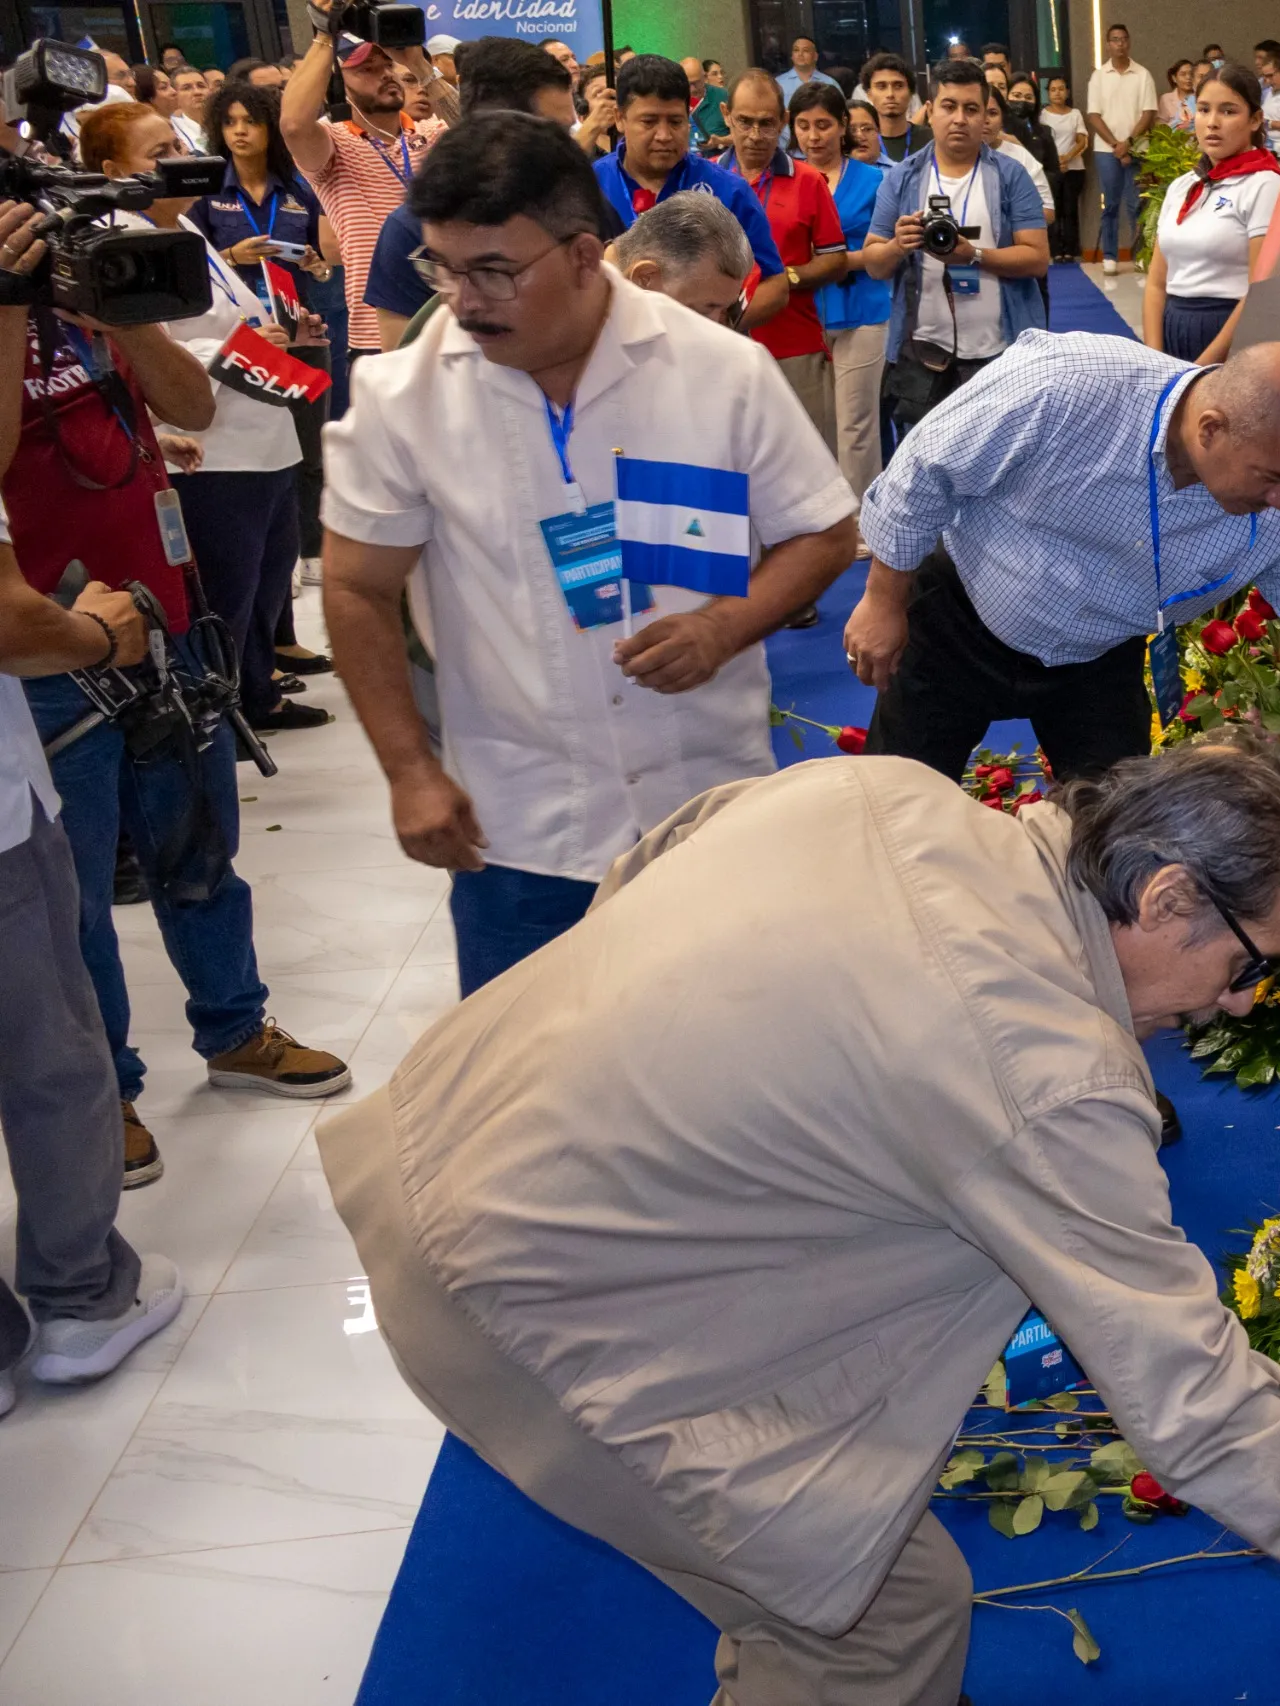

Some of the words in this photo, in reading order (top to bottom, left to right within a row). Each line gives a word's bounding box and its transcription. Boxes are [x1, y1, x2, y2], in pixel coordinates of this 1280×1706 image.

[427, 4, 442, 20] e
[453, 0, 577, 20] identidad
[516, 21, 577, 33] Nacional
[221, 350, 309, 399] FSLN
